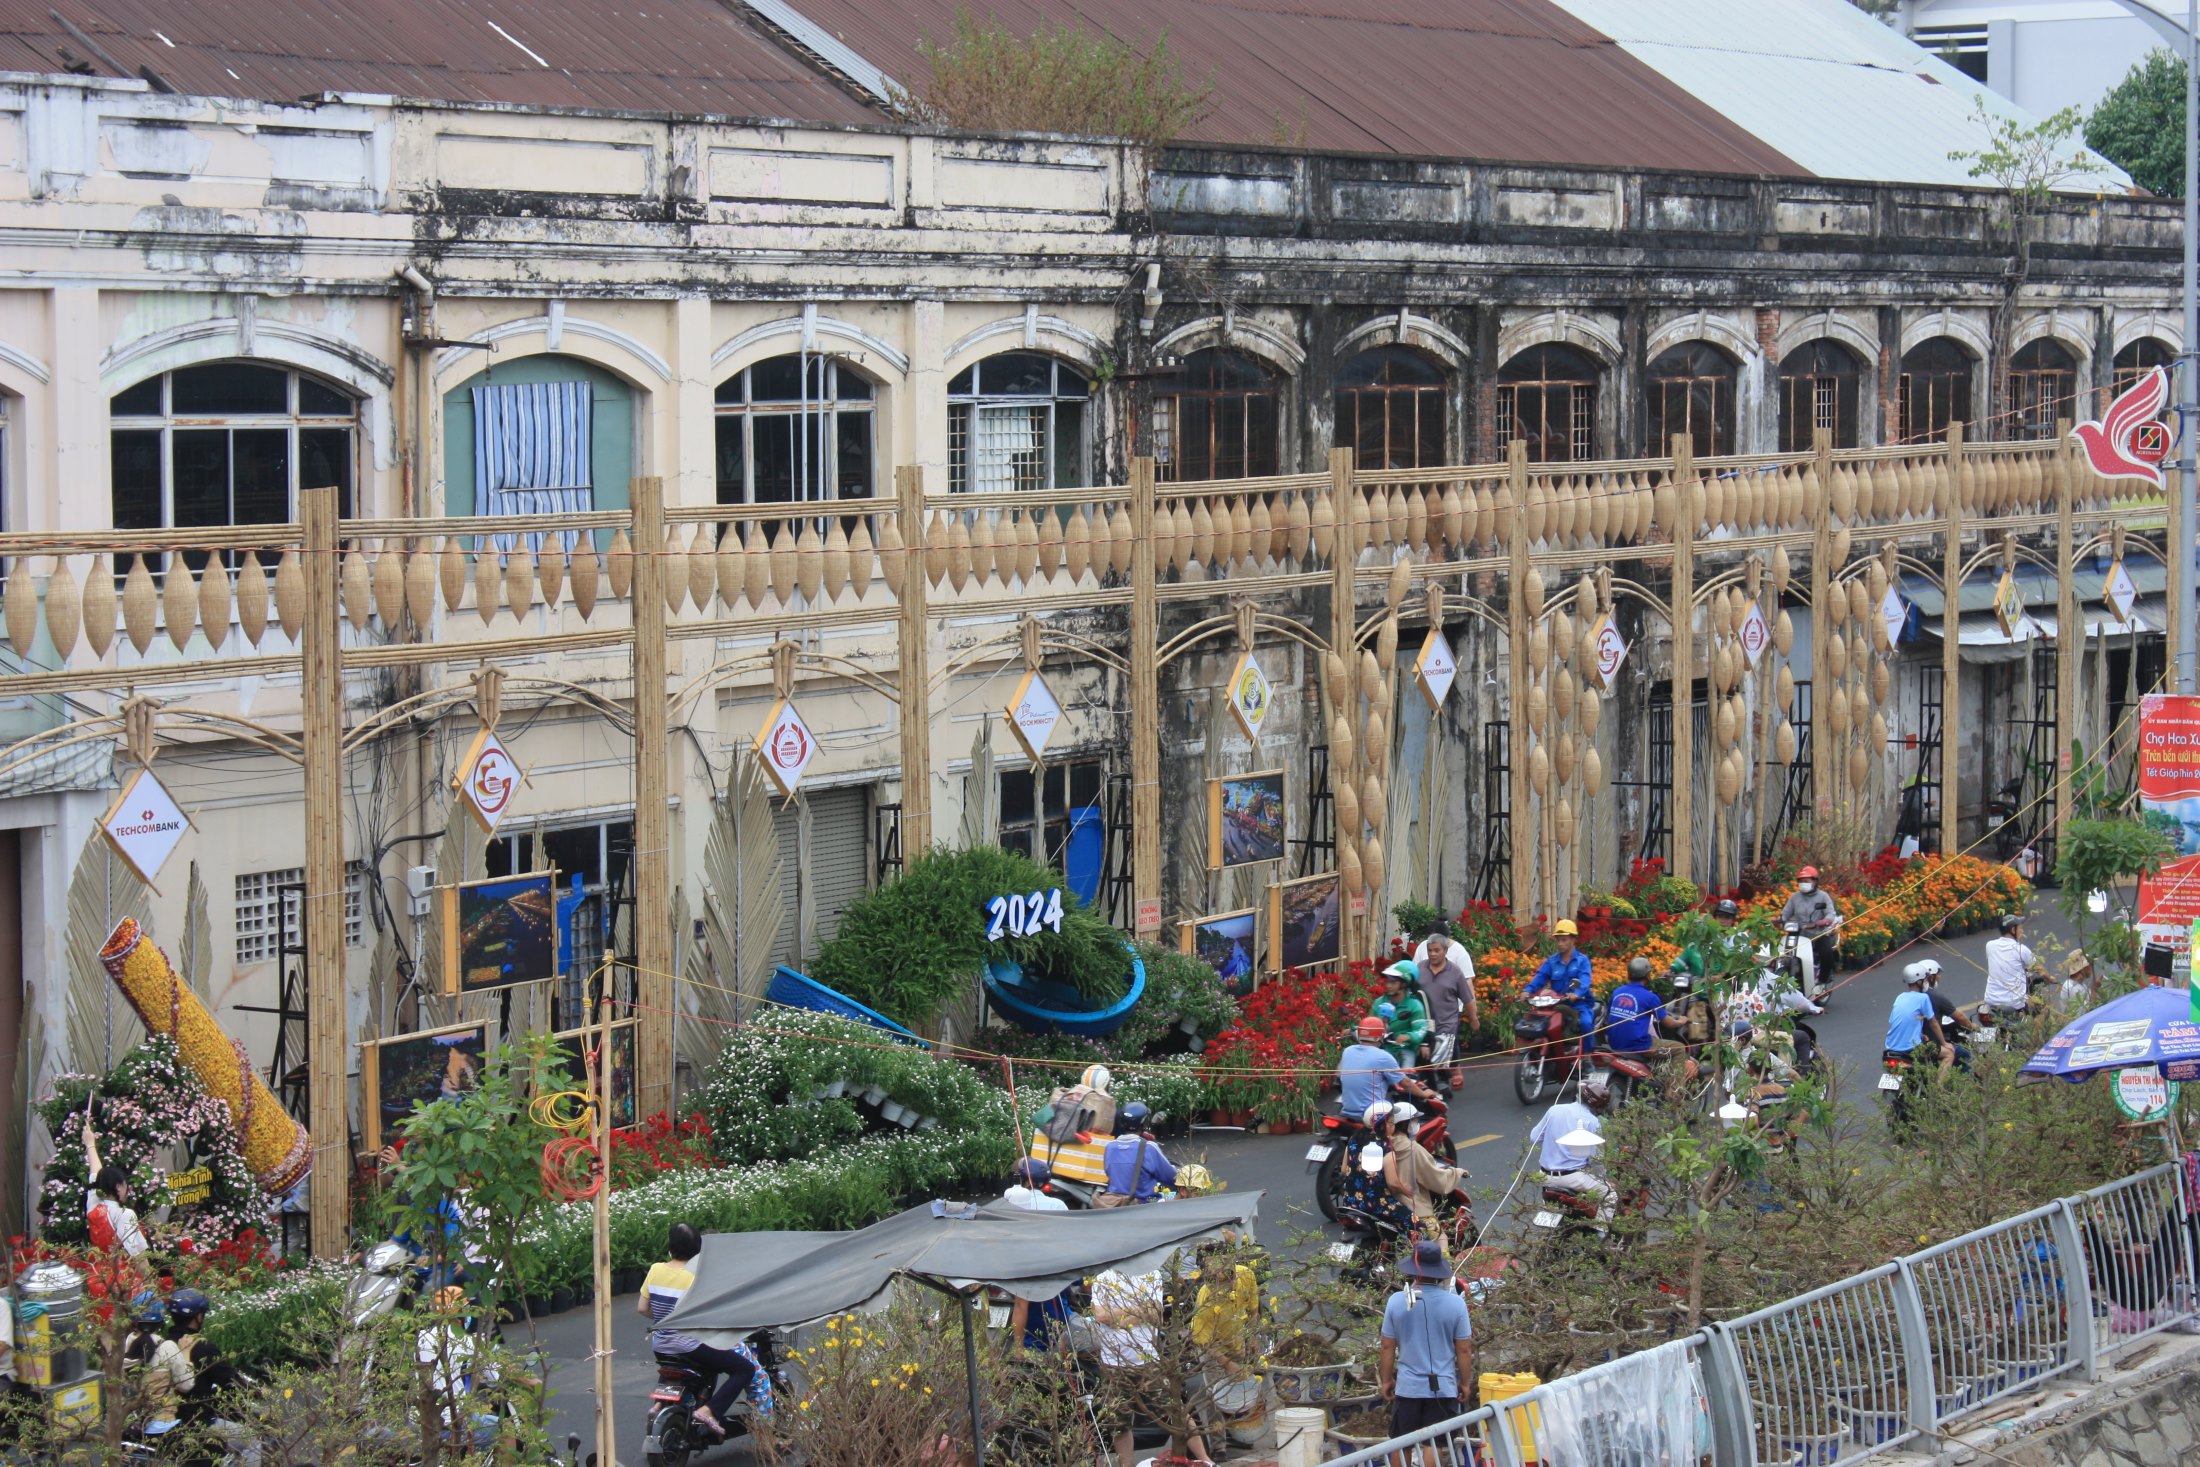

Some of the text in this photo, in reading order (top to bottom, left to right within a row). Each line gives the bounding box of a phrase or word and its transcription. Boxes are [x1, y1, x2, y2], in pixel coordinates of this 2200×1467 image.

[2145, 731, 2165, 747] Chợ
[2167, 732, 2187, 745] Hoa
[116, 821, 180, 837] TECHCOMBANK
[986, 887, 1065, 942] 2024
[2150, 1094, 2163, 1105] 114
